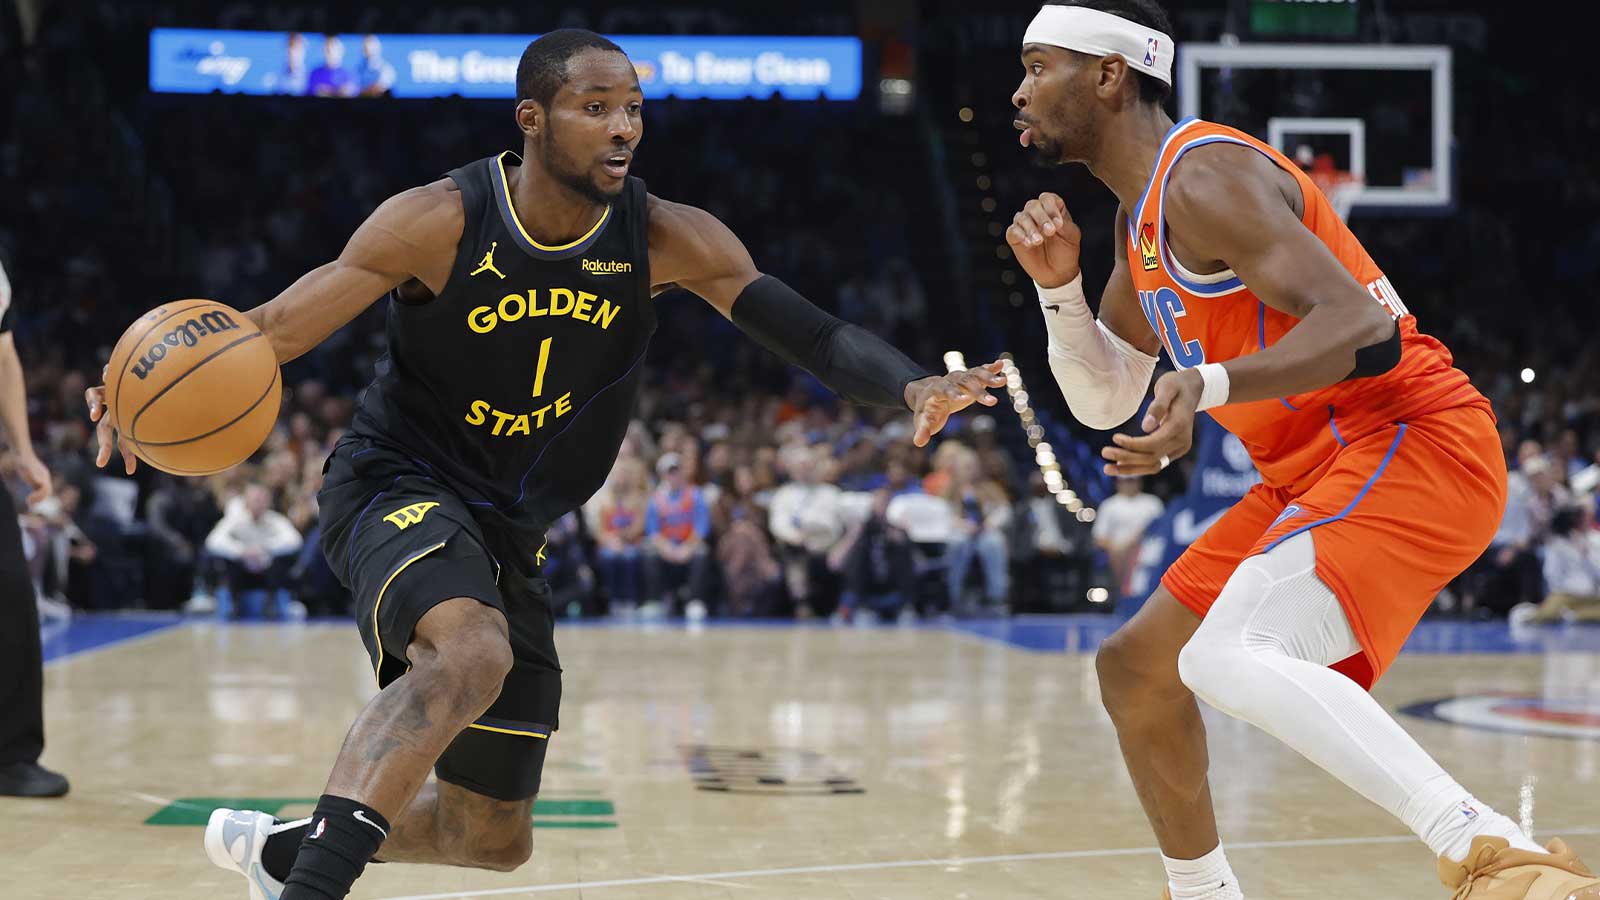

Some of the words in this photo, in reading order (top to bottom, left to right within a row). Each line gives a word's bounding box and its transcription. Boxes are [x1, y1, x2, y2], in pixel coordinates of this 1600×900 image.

[408, 50, 458, 84] The
[659, 51, 694, 84] To
[695, 51, 751, 84] Ever
[755, 51, 831, 85] Clean
[582, 258, 632, 275] Rakuten
[467, 287, 621, 334] GOLDEN
[130, 310, 241, 381] Wilson
[532, 336, 553, 398] 1
[464, 391, 573, 437] STATE
